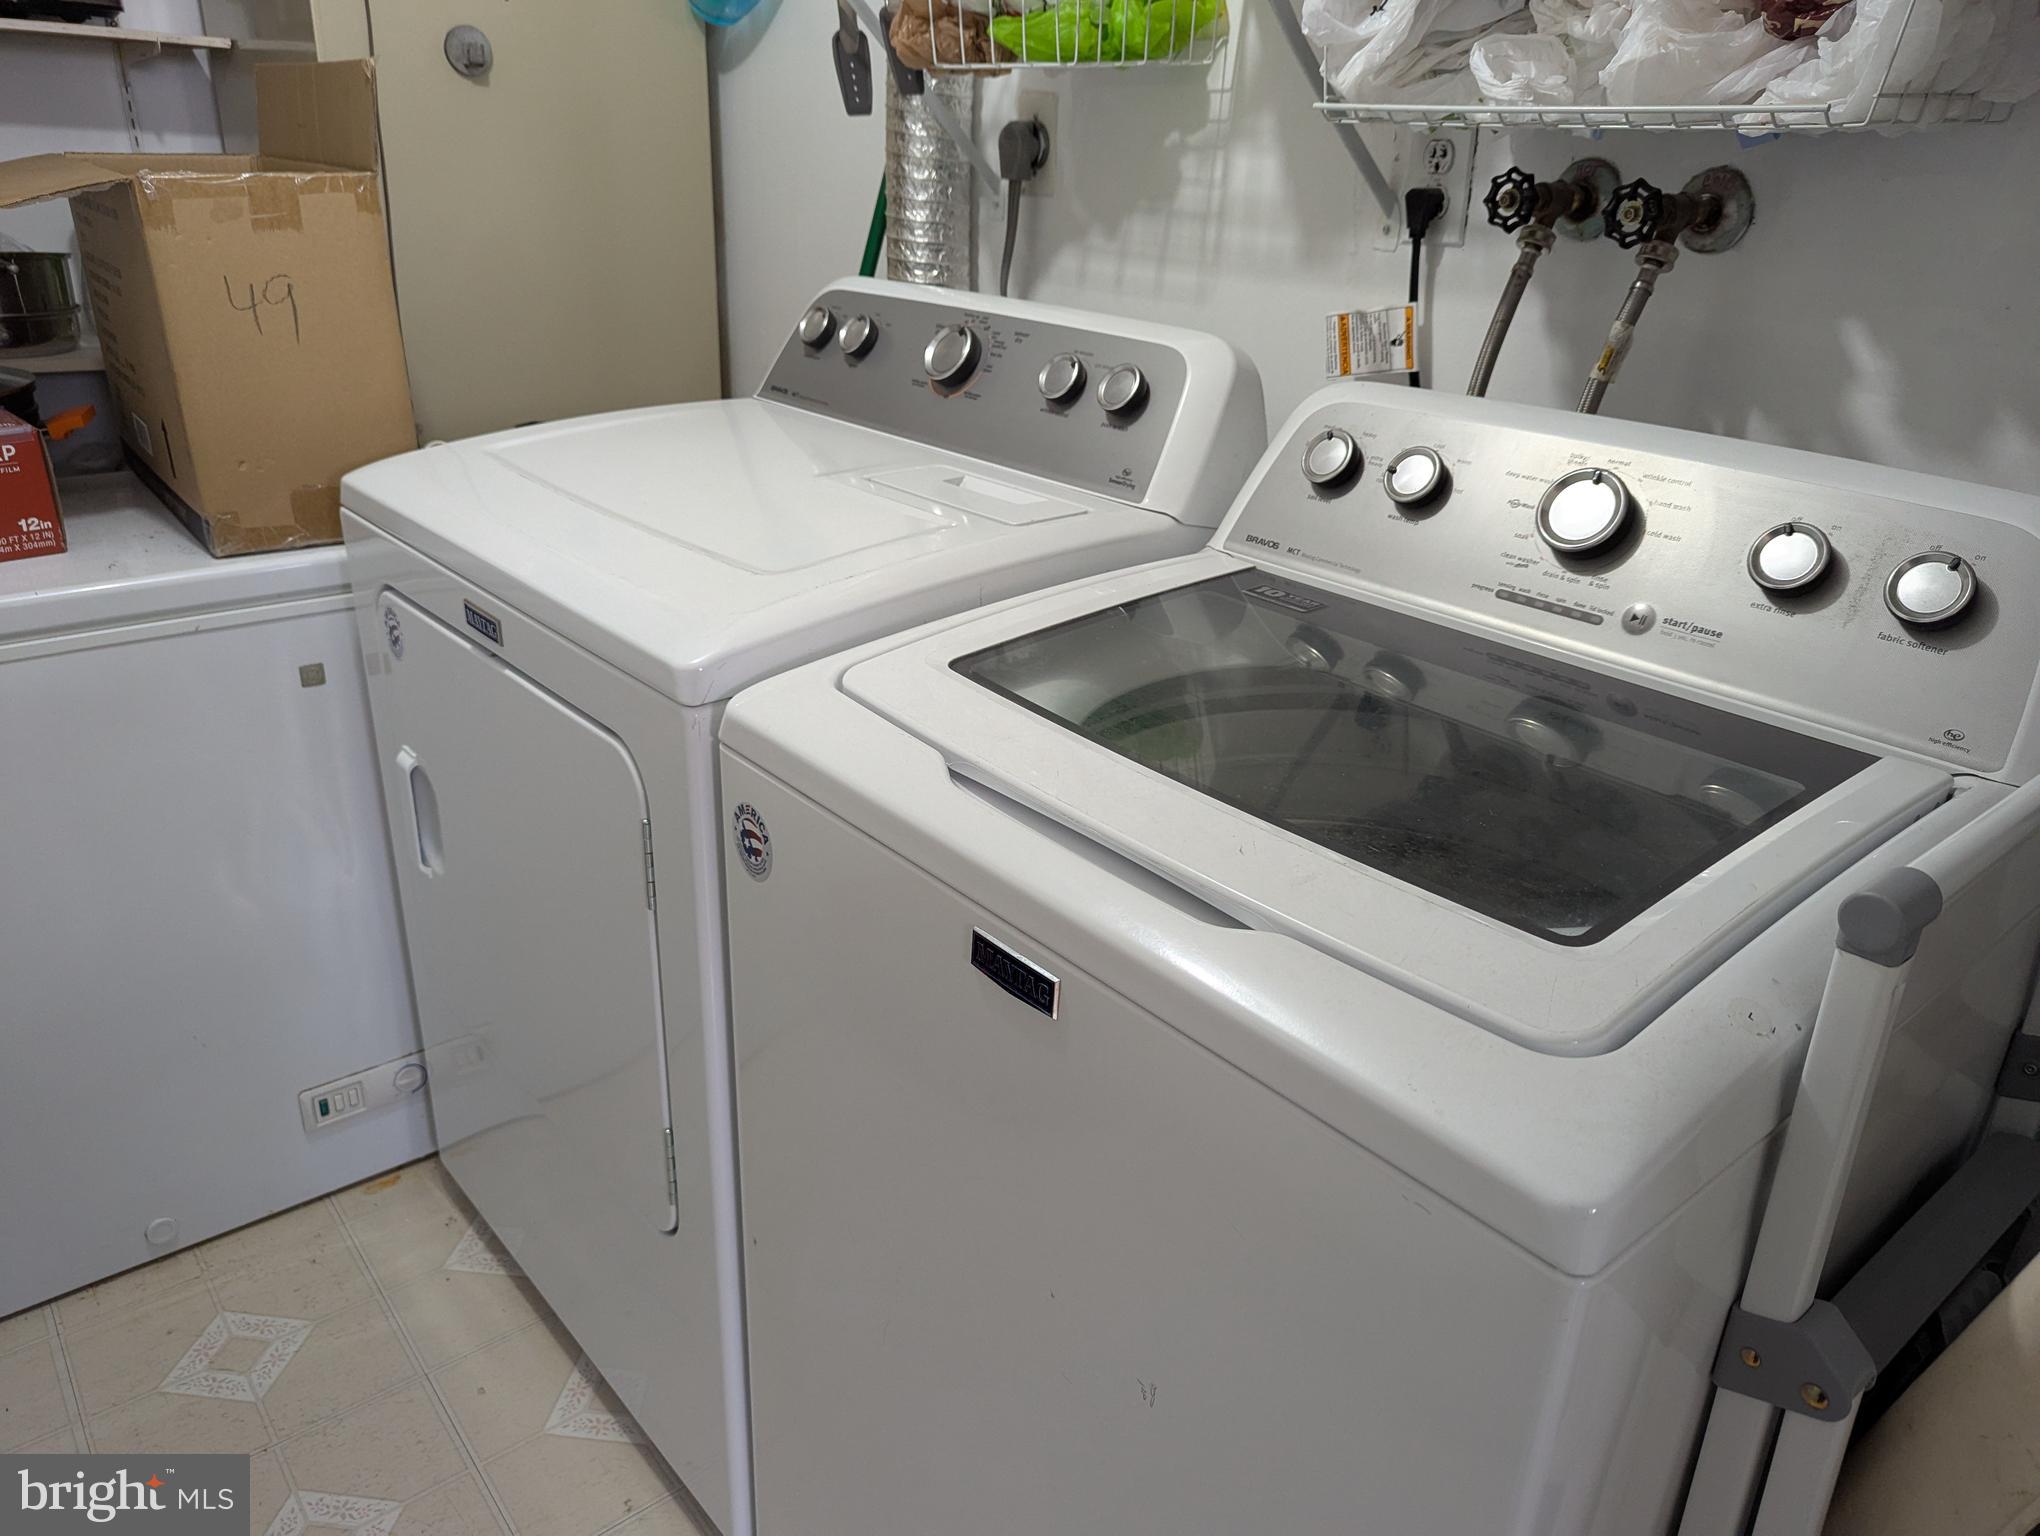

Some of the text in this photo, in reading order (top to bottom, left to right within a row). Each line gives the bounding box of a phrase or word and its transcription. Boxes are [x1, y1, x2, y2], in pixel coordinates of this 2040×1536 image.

[223, 274, 300, 344] 49
[0, 444, 16, 461] P
[0, 466, 20, 474] FILM
[18, 517, 52, 532] 12in
[9, 535, 19, 544] FT
[21, 534, 28, 542] X
[30, 532, 40, 540] 12
[1246, 534, 1280, 550] BRAVOS
[15, 543, 21, 551] X
[1975, 554, 1987, 562] on
[1750, 601, 1796, 618] extra rinse
[1661, 616, 1723, 639] start/pause
[1877, 631, 1949, 656] fabric softener
[1928, 736, 1971, 754] high efficiency
[734, 803, 770, 846] AMERICA
